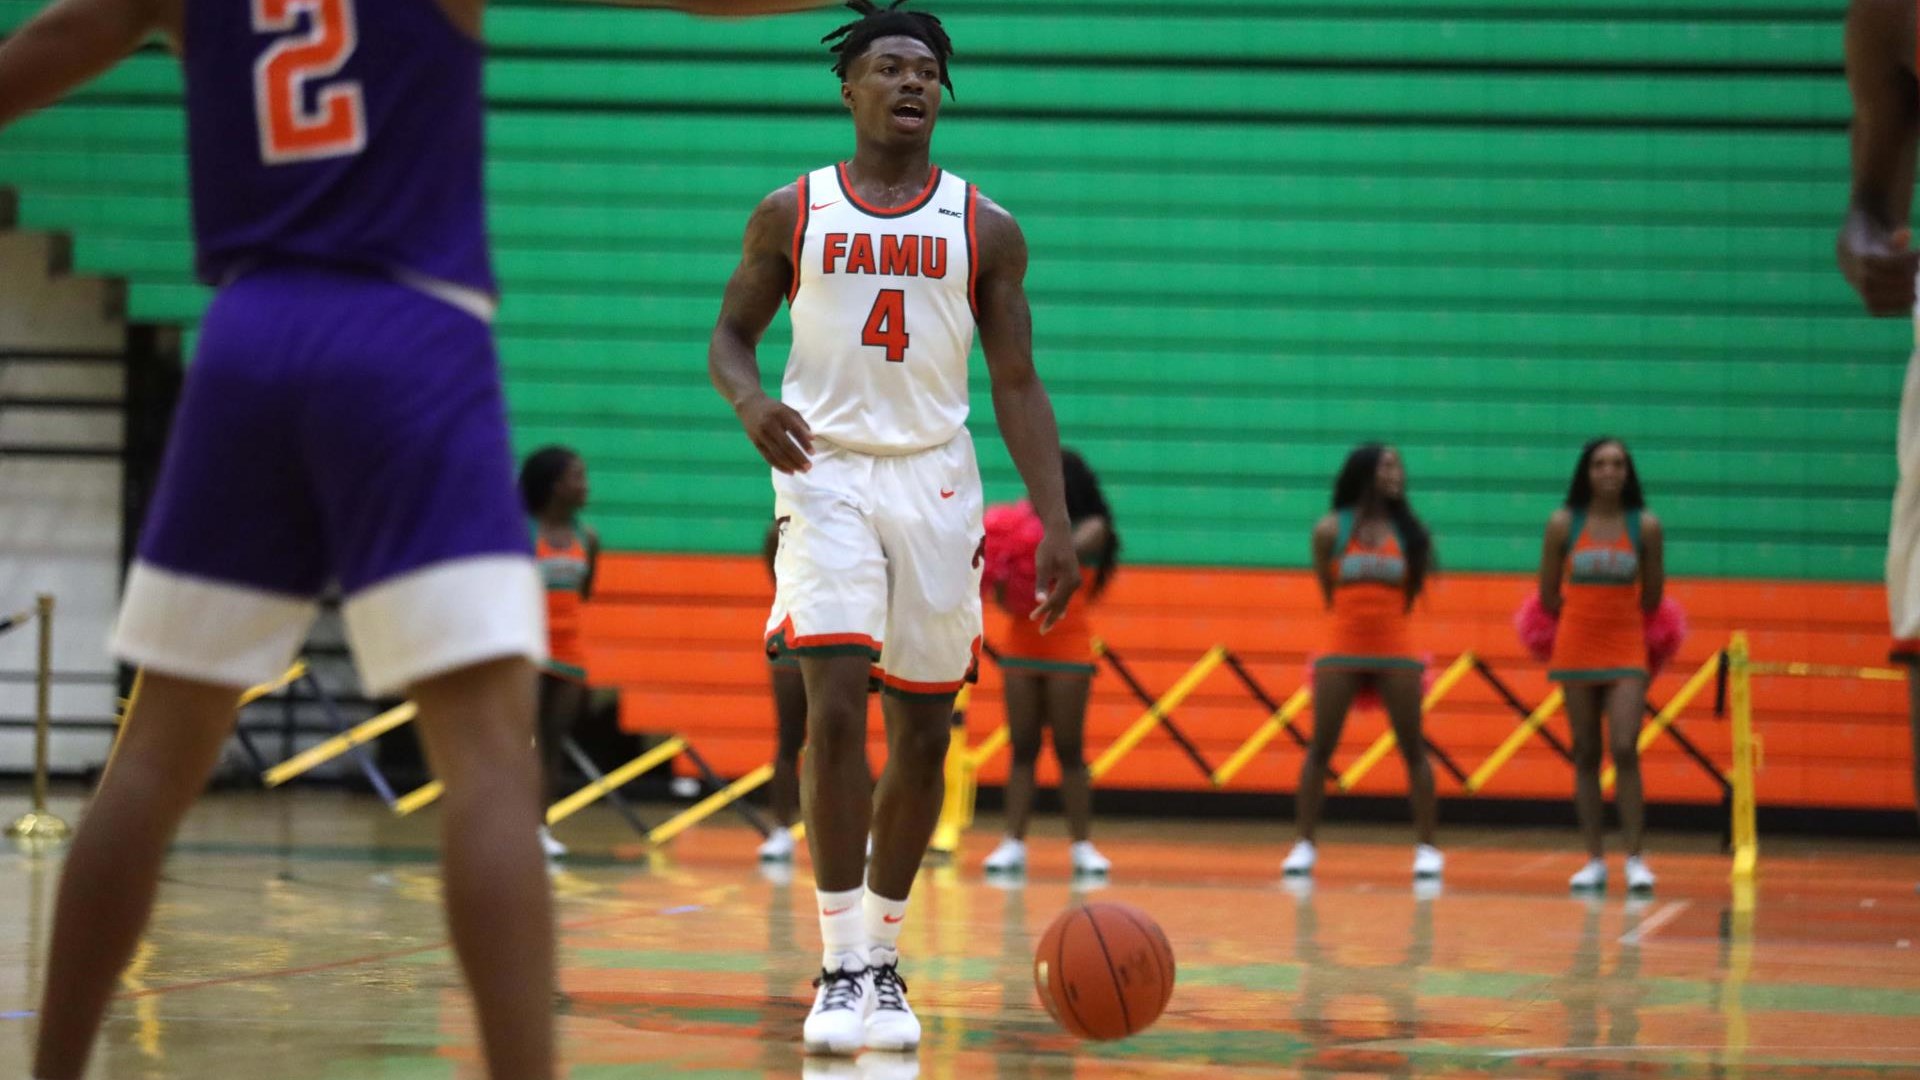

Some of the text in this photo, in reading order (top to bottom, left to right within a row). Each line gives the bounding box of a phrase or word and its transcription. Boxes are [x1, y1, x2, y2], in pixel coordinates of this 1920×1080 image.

[252, 0, 366, 166] 2
[938, 207, 962, 218] MEAC
[823, 233, 947, 279] FAMU
[862, 289, 909, 362] 4
